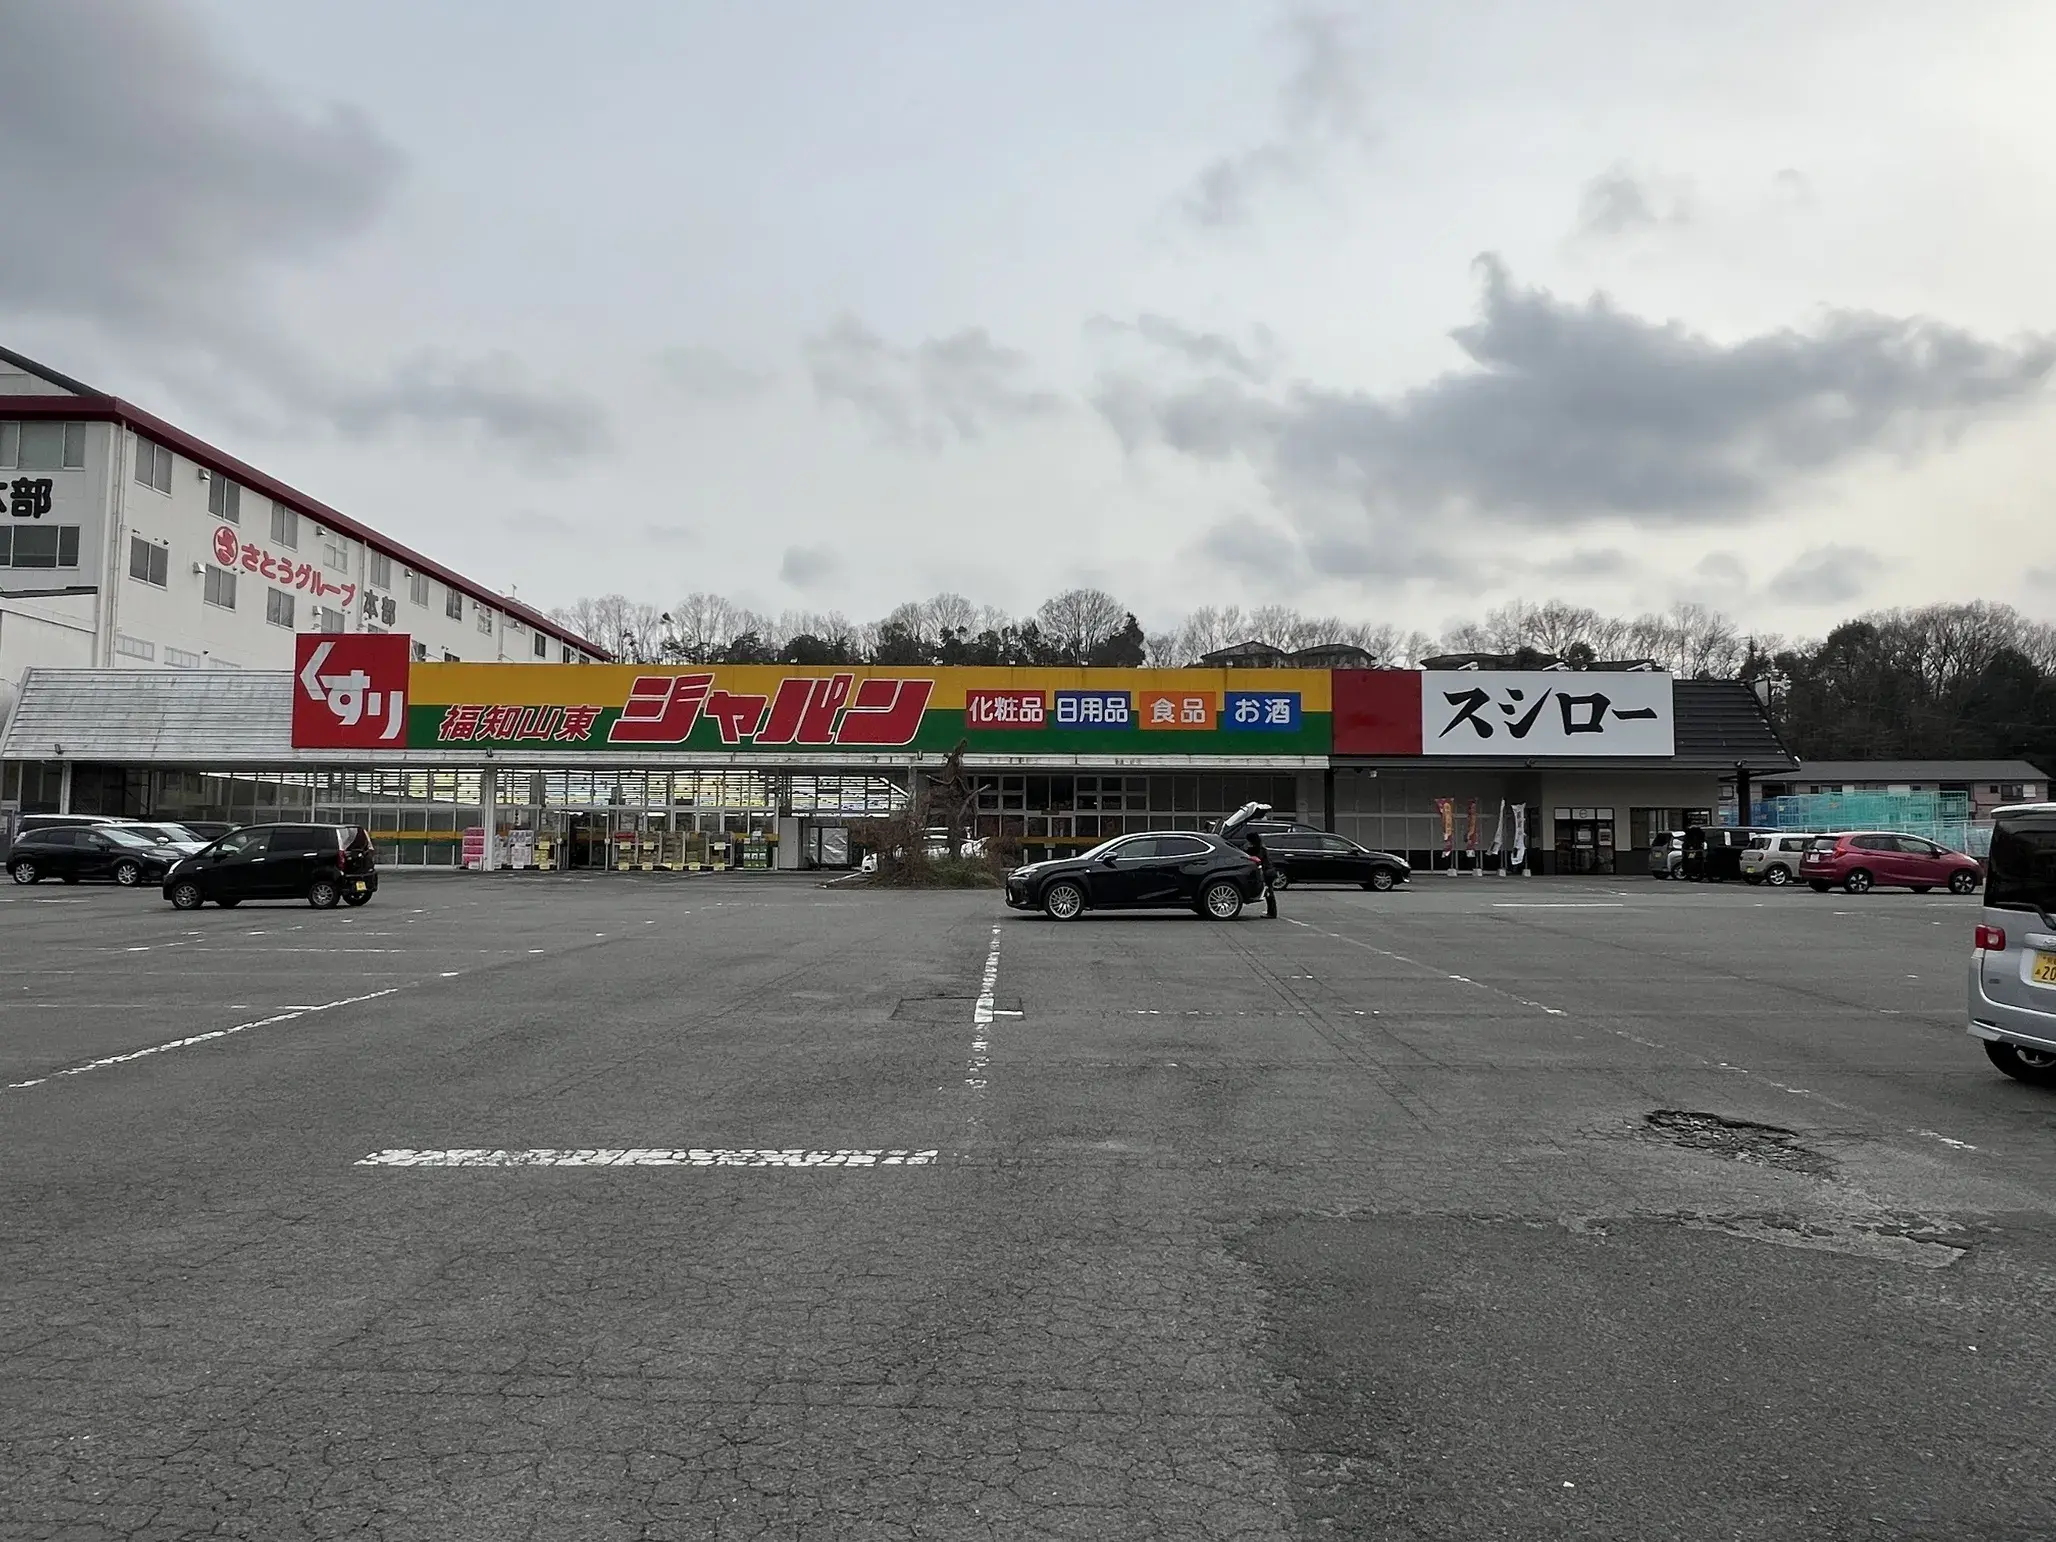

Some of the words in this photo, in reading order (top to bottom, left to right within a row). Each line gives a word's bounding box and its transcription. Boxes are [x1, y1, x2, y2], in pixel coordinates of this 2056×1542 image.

[0, 477, 53, 519] 部
[241, 543, 356, 607] さとうグループ
[364, 589, 397, 627] 本部
[299, 641, 404, 740] くすり
[437, 704, 602, 742] 福知山東
[607, 673, 935, 745] ジャパン
[968, 696, 1044, 723] 化粧品
[1056, 697, 1128, 723] 日用品
[1150, 697, 1206, 724] 食品
[1235, 698, 1291, 724] お酒
[1438, 687, 1658, 739] スシロー
